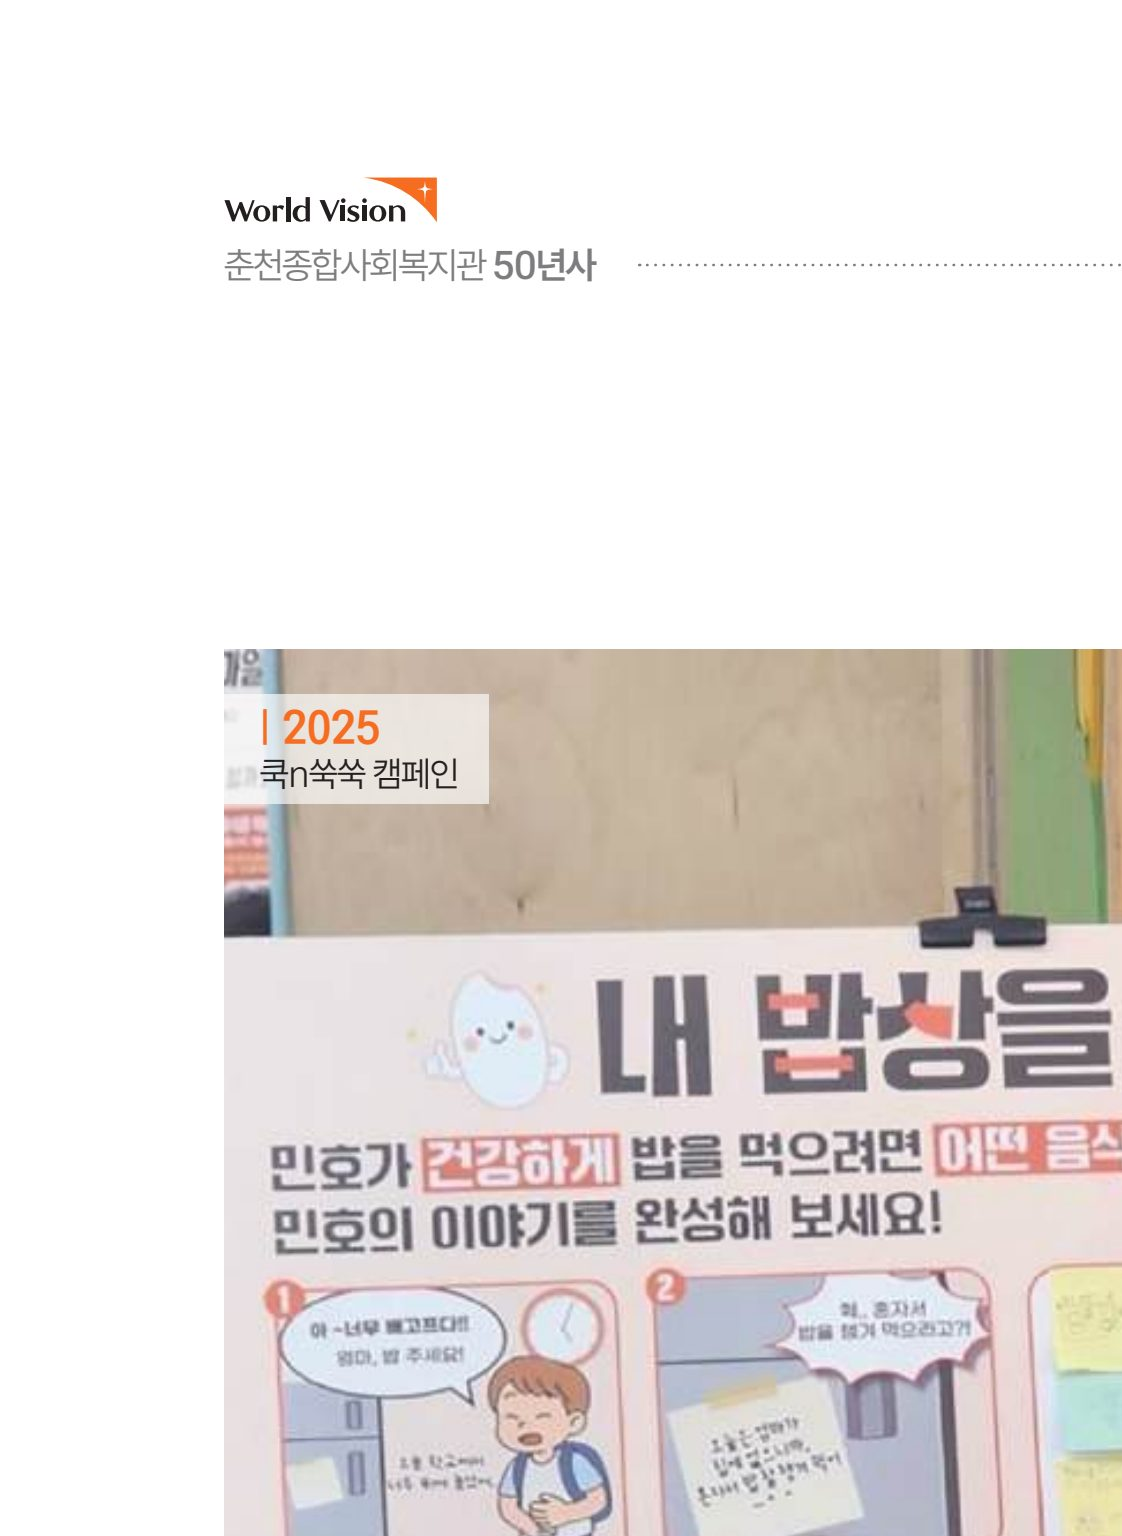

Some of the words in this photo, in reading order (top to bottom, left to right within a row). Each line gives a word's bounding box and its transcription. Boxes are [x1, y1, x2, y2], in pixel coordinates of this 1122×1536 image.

[596, 975, 712, 1097] 내
[755, 967, 1113, 1094] 밥상을
[270, 1143, 412, 1192] 민호가
[425, 1135, 619, 1189] 건강하게
[631, 1134, 722, 1181] 밥을
[738, 1127, 922, 1177] 먹으려면
[938, 1125, 1028, 1172] 어떤
[274, 1205, 413, 1254] 민호의
[431, 1200, 617, 1250] 이야기를
[635, 1196, 772, 1244] 완성해
[791, 1190, 942, 1240] 보세요!
[277, 1286, 290, 1313] 1
[658, 1275, 675, 1299] 2
[873, 1301, 927, 1319] 혼자서
[798, 1324, 834, 1342] 밥을
[382, 1348, 400, 1365] 밥
